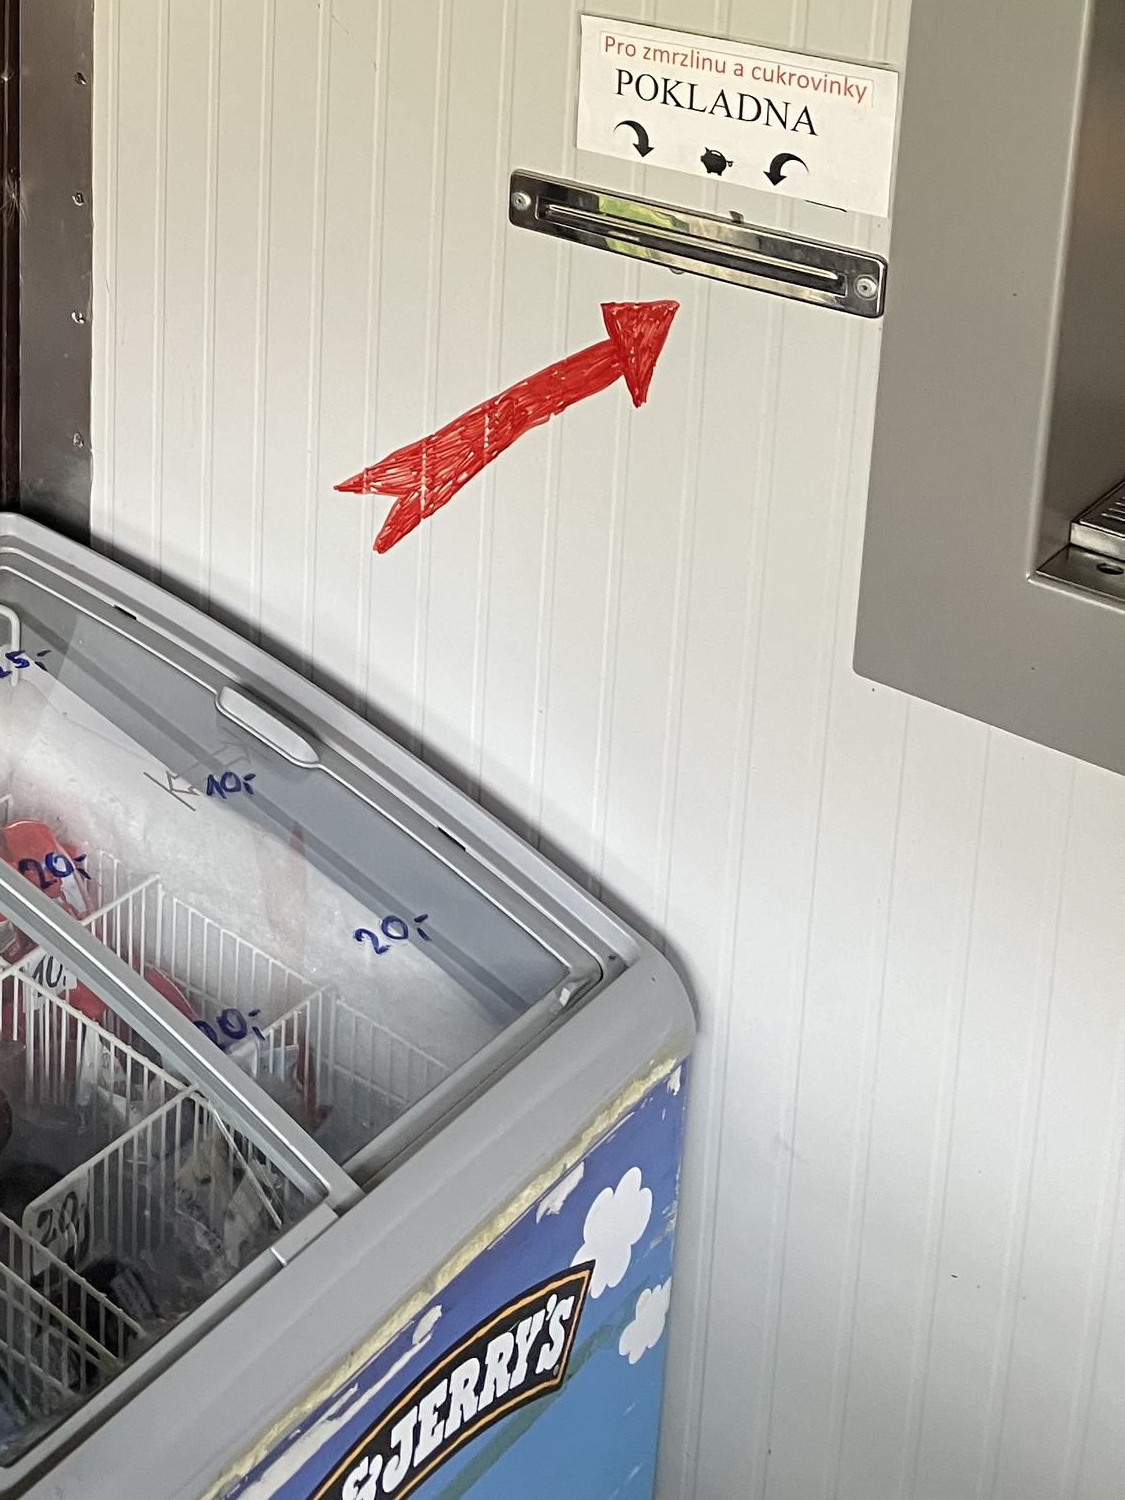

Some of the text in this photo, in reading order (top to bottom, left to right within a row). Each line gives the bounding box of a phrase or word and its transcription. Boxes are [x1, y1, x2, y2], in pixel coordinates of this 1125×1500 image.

[604, 35, 868, 104] Pro zmrzlinu a cukrovinky
[614, 67, 819, 137] POKLADNA
[382, 1294, 575, 1493] JERRY'S
